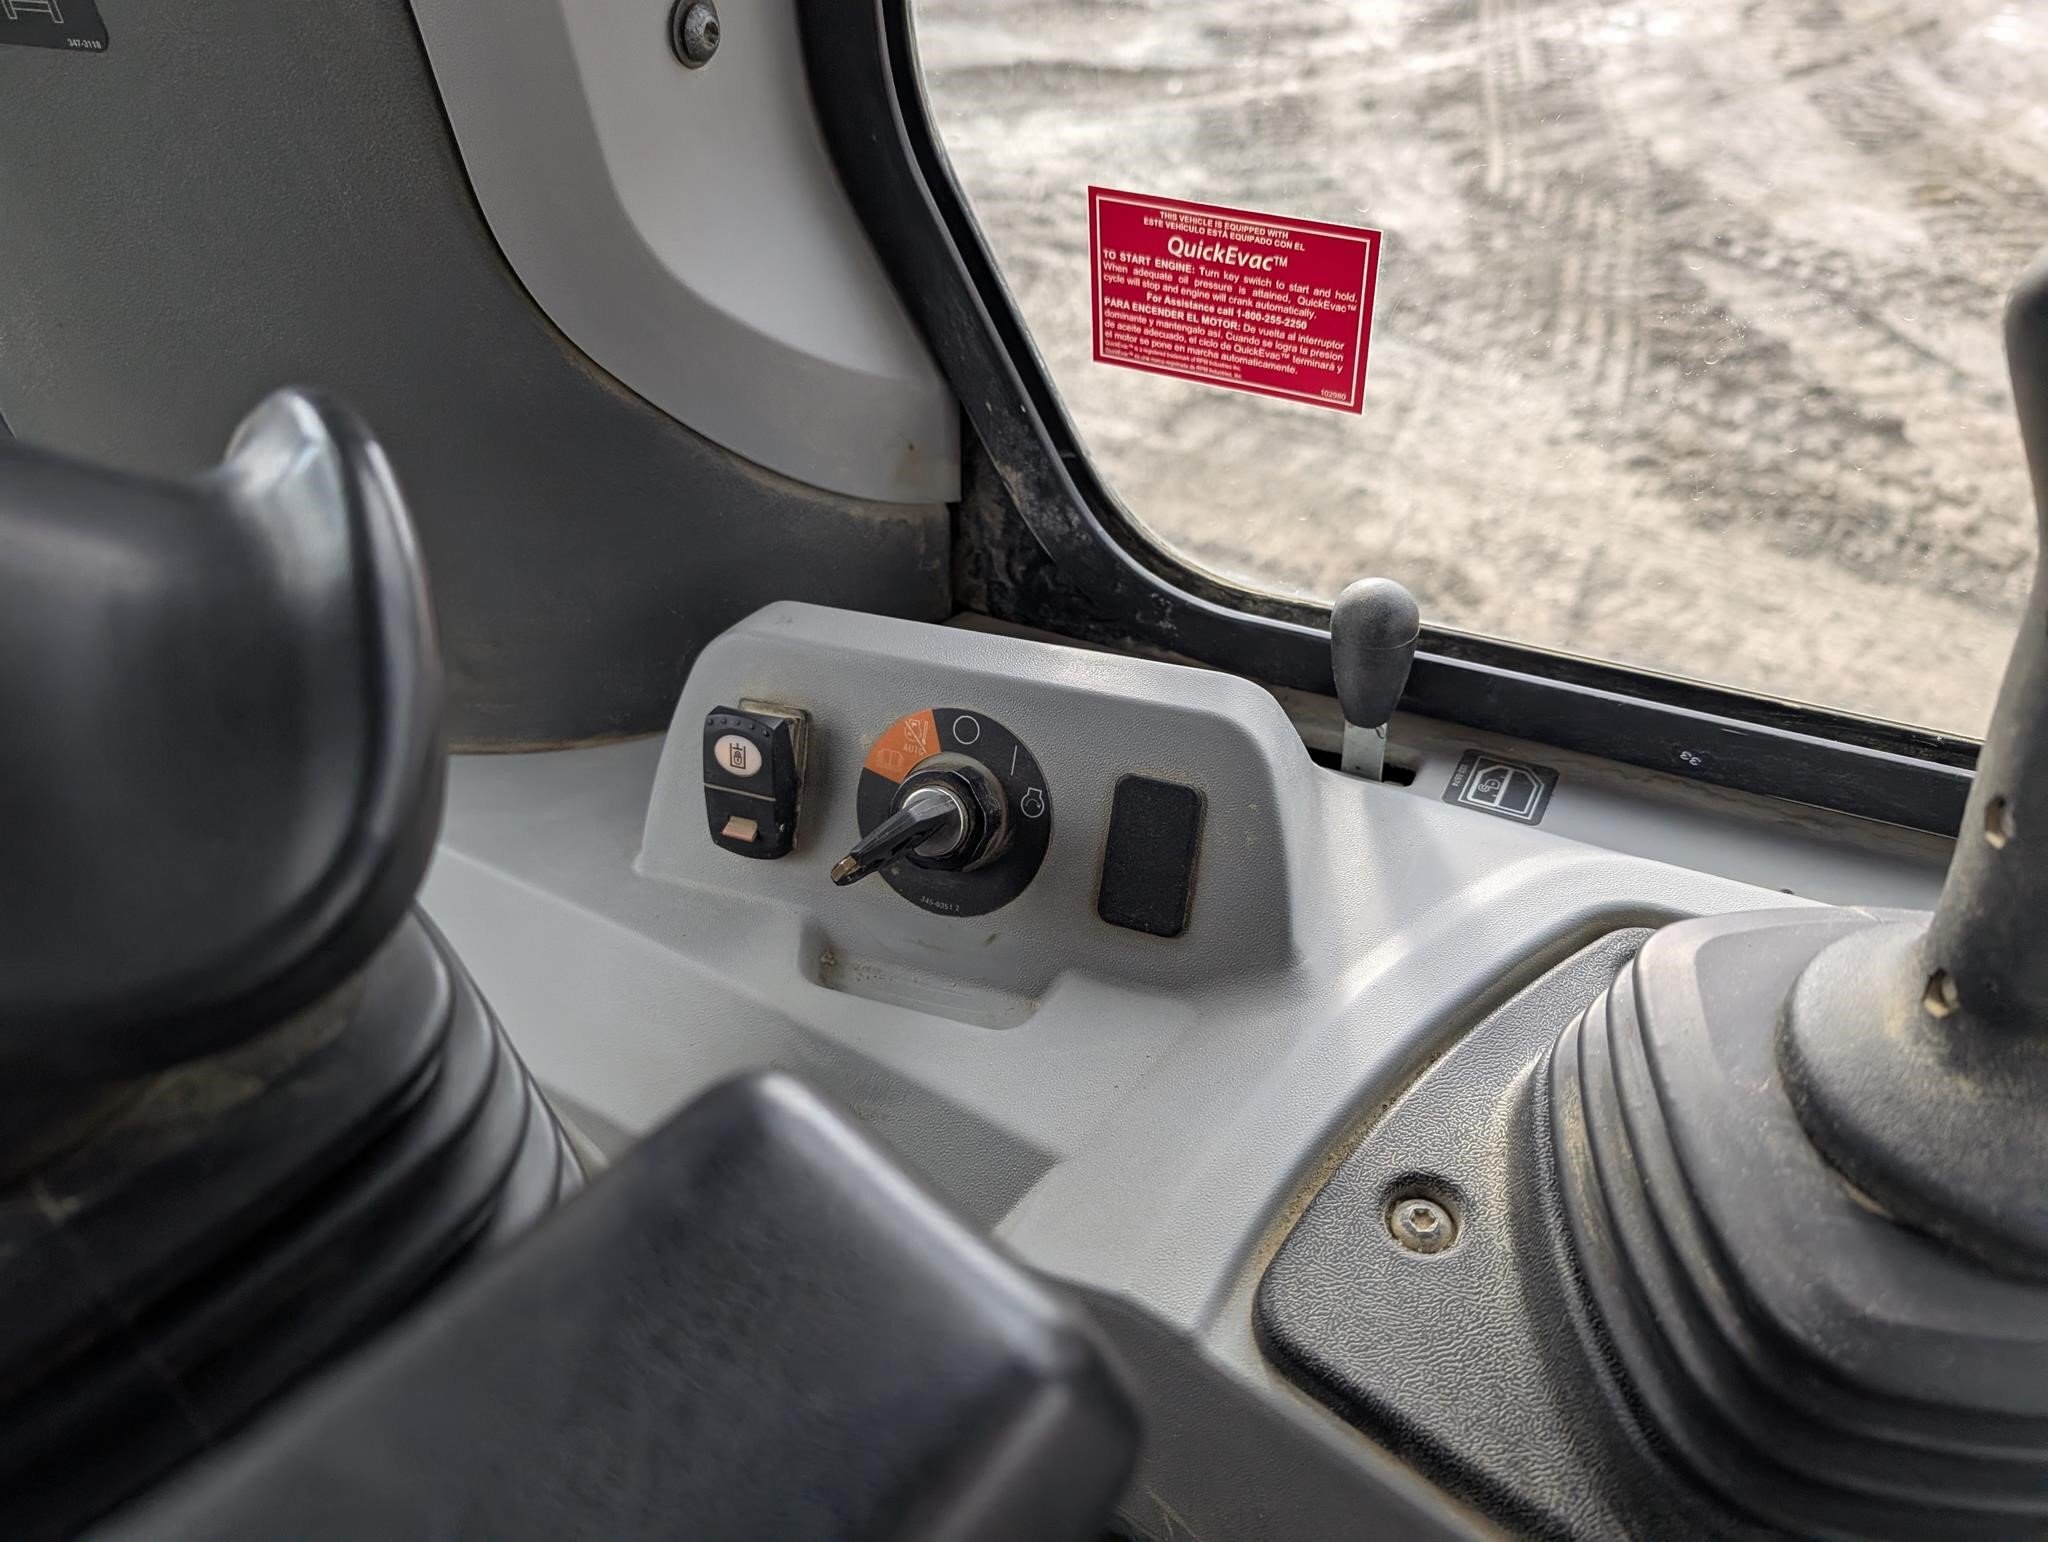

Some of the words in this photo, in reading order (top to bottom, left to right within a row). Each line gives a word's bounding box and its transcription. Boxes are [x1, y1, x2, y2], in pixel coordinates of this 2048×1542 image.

[1143, 216, 1163, 228] ESTE
[1229, 231, 1272, 246] EQUIPADO
[1274, 239, 1293, 249] CON
[1294, 242, 1305, 251] EL
[1159, 211, 1177, 221] THIS
[1178, 214, 1213, 227] VEHICLE
[1214, 220, 1222, 229] IS
[1224, 222, 1266, 235] EQUIPPED
[1267, 229, 1288, 239] WITH
[1102, 260, 1128, 273] When
[1133, 267, 1173, 281] adequate
[1178, 275, 1189, 284] oil
[1194, 278, 1232, 292] pressure
[1238, 285, 1246, 295] is
[1103, 248, 1116, 260] TO
[1119, 252, 1151, 266] START
[1154, 257, 1195, 273] ENGINE:
[1199, 265, 1220, 278] Turn
[1223, 270, 1240, 283] key
[1243, 275, 1272, 287] switch
[1275, 279, 1285, 290] to
[1288, 283, 1309, 294] start
[1313, 288, 1331, 298] and
[1103, 273, 1125, 284] cycle
[1126, 277, 1140, 286] will
[1142, 279, 1160, 292] stop
[1162, 284, 1179, 294] and
[1180, 287, 1210, 300] engine
[1211, 293, 1226, 302] will
[1228, 296, 1253, 307] crank
[1255, 301, 1316, 320] automatically.
[1146, 291, 1162, 303] For
[1164, 295, 1215, 313] Assistance
[1216, 306, 1234, 316] call
[1236, 308, 1307, 330] 1-800-255-2250
[1104, 296, 1130, 310] PARA
[1131, 301, 1184, 320] ENCENDER
[1186, 312, 1199, 323] EL
[1201, 314, 1240, 331] MOTOR:
[1258, 327, 1285, 339] vuelta
[1287, 332, 1296, 341] al
[1297, 333, 1344, 350] interruptor
[1104, 308, 1147, 324] dominante
[1148, 318, 1154, 327] y
[1225, 331, 1260, 346] Cuando
[1261, 339, 1273, 348] se
[1275, 340, 1297, 353] logra
[1299, 344, 1308, 355] la
[1104, 330, 1112, 340] el
[1114, 332, 1137, 345] motor
[1139, 337, 1149, 346] se
[1151, 339, 1172, 350] pone
[1174, 344, 1185, 352] en
[1187, 346, 1219, 359] marcha
[1104, 319, 1115, 329] de
[1116, 323, 1142, 334] aceite
[1188, 336, 1197, 344] el
[1198, 337, 1219, 348] ciclo
[1219, 341, 1232, 351] de
[1336, 365, 1343, 374] y
